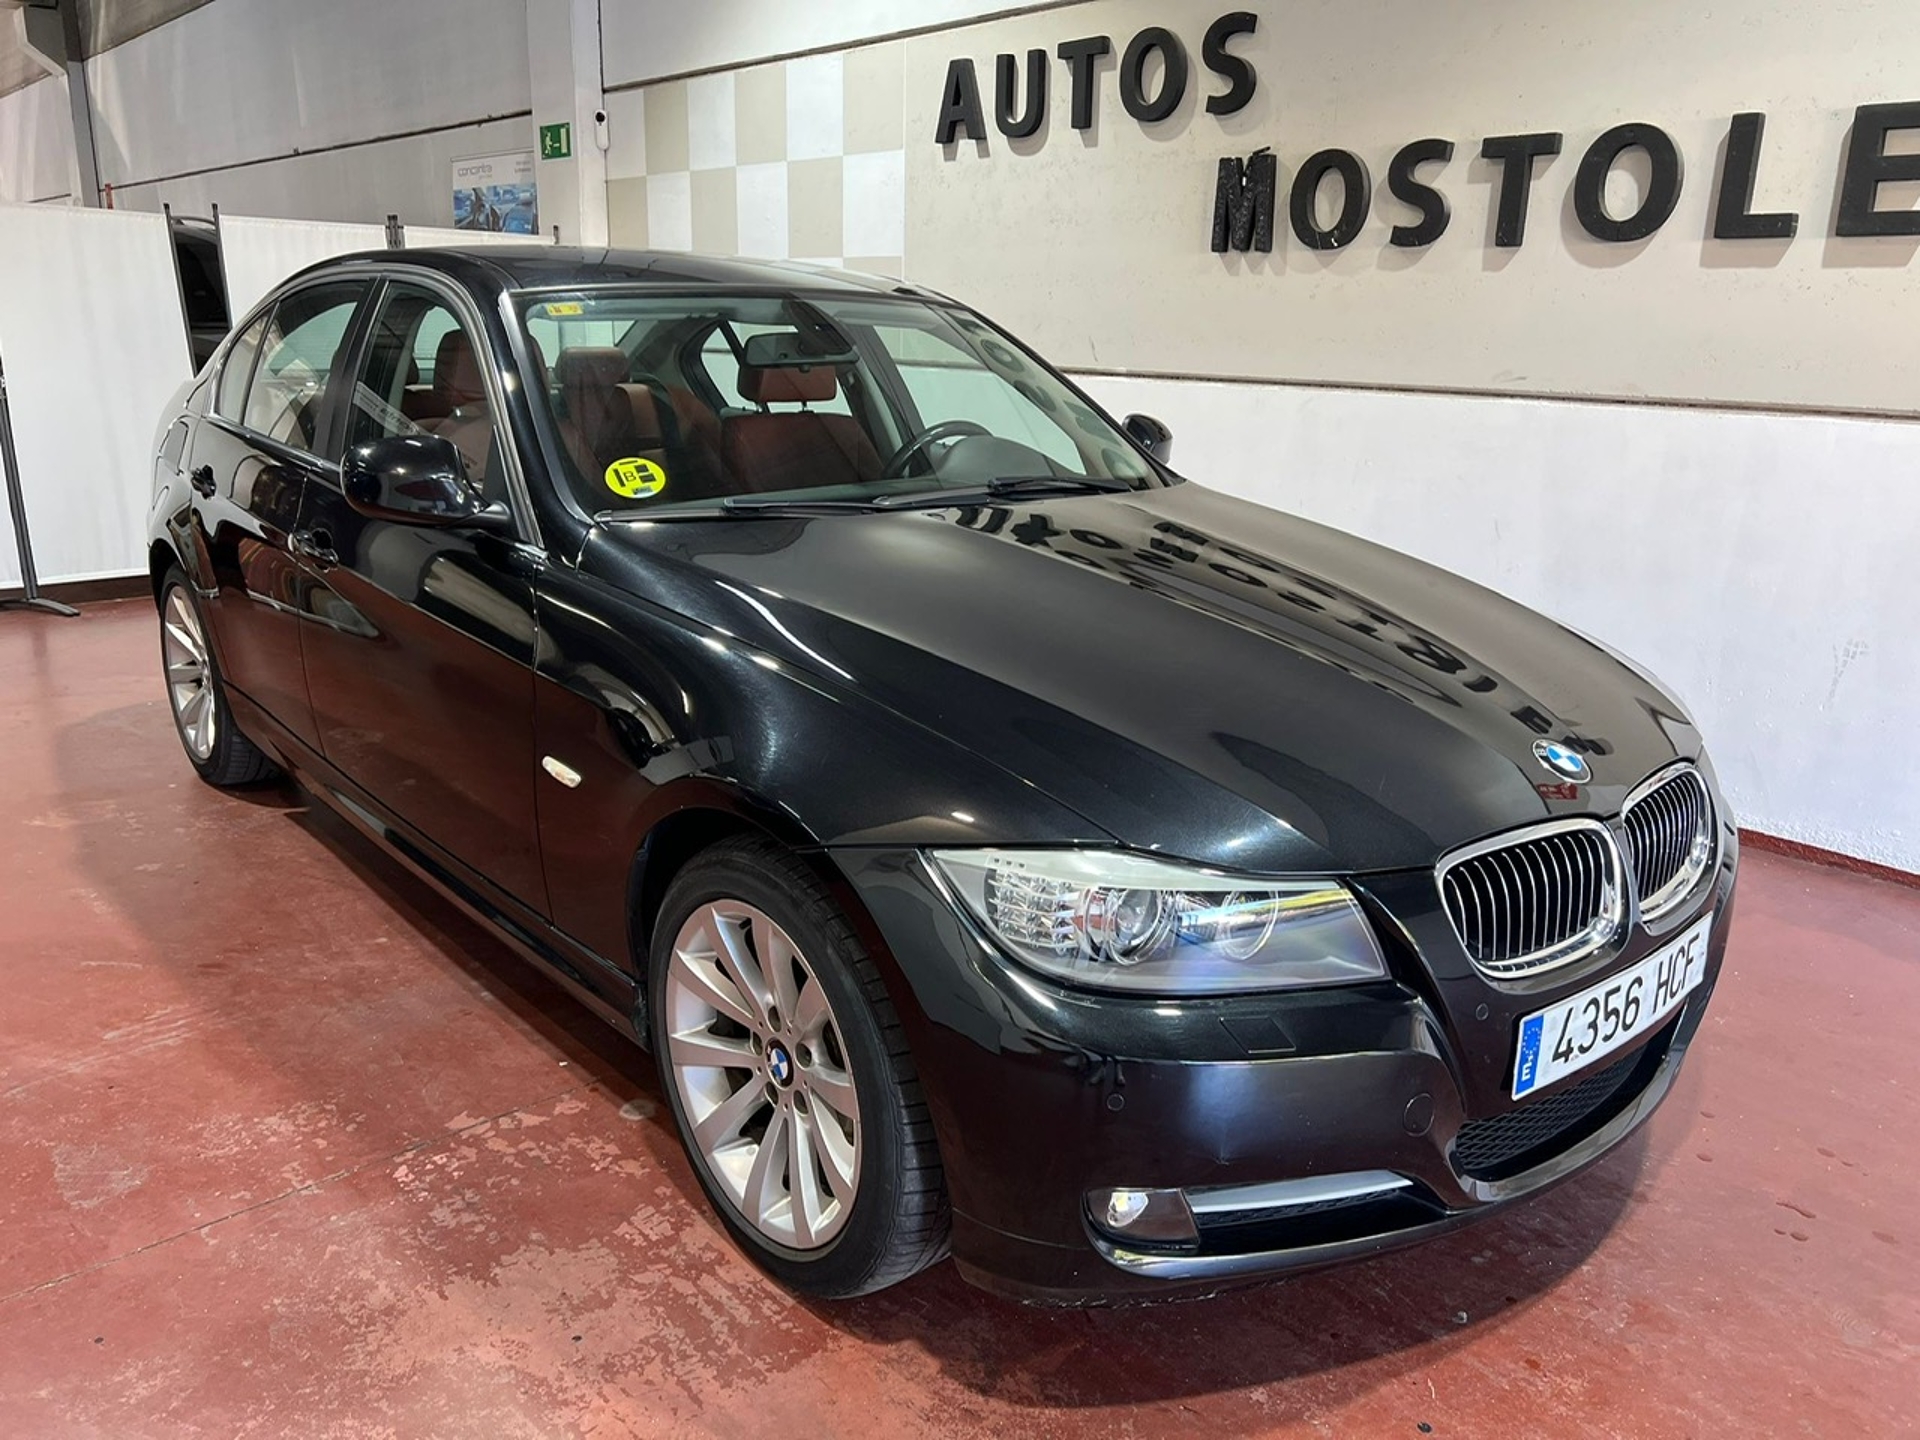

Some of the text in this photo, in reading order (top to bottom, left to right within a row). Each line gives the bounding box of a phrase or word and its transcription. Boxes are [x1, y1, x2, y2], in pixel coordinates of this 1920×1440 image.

[935, 11, 1258, 144] AUTOS
[1211, 101, 1920, 253] MOSTOLE
[1552, 932, 1700, 1064] 4356 HCF
